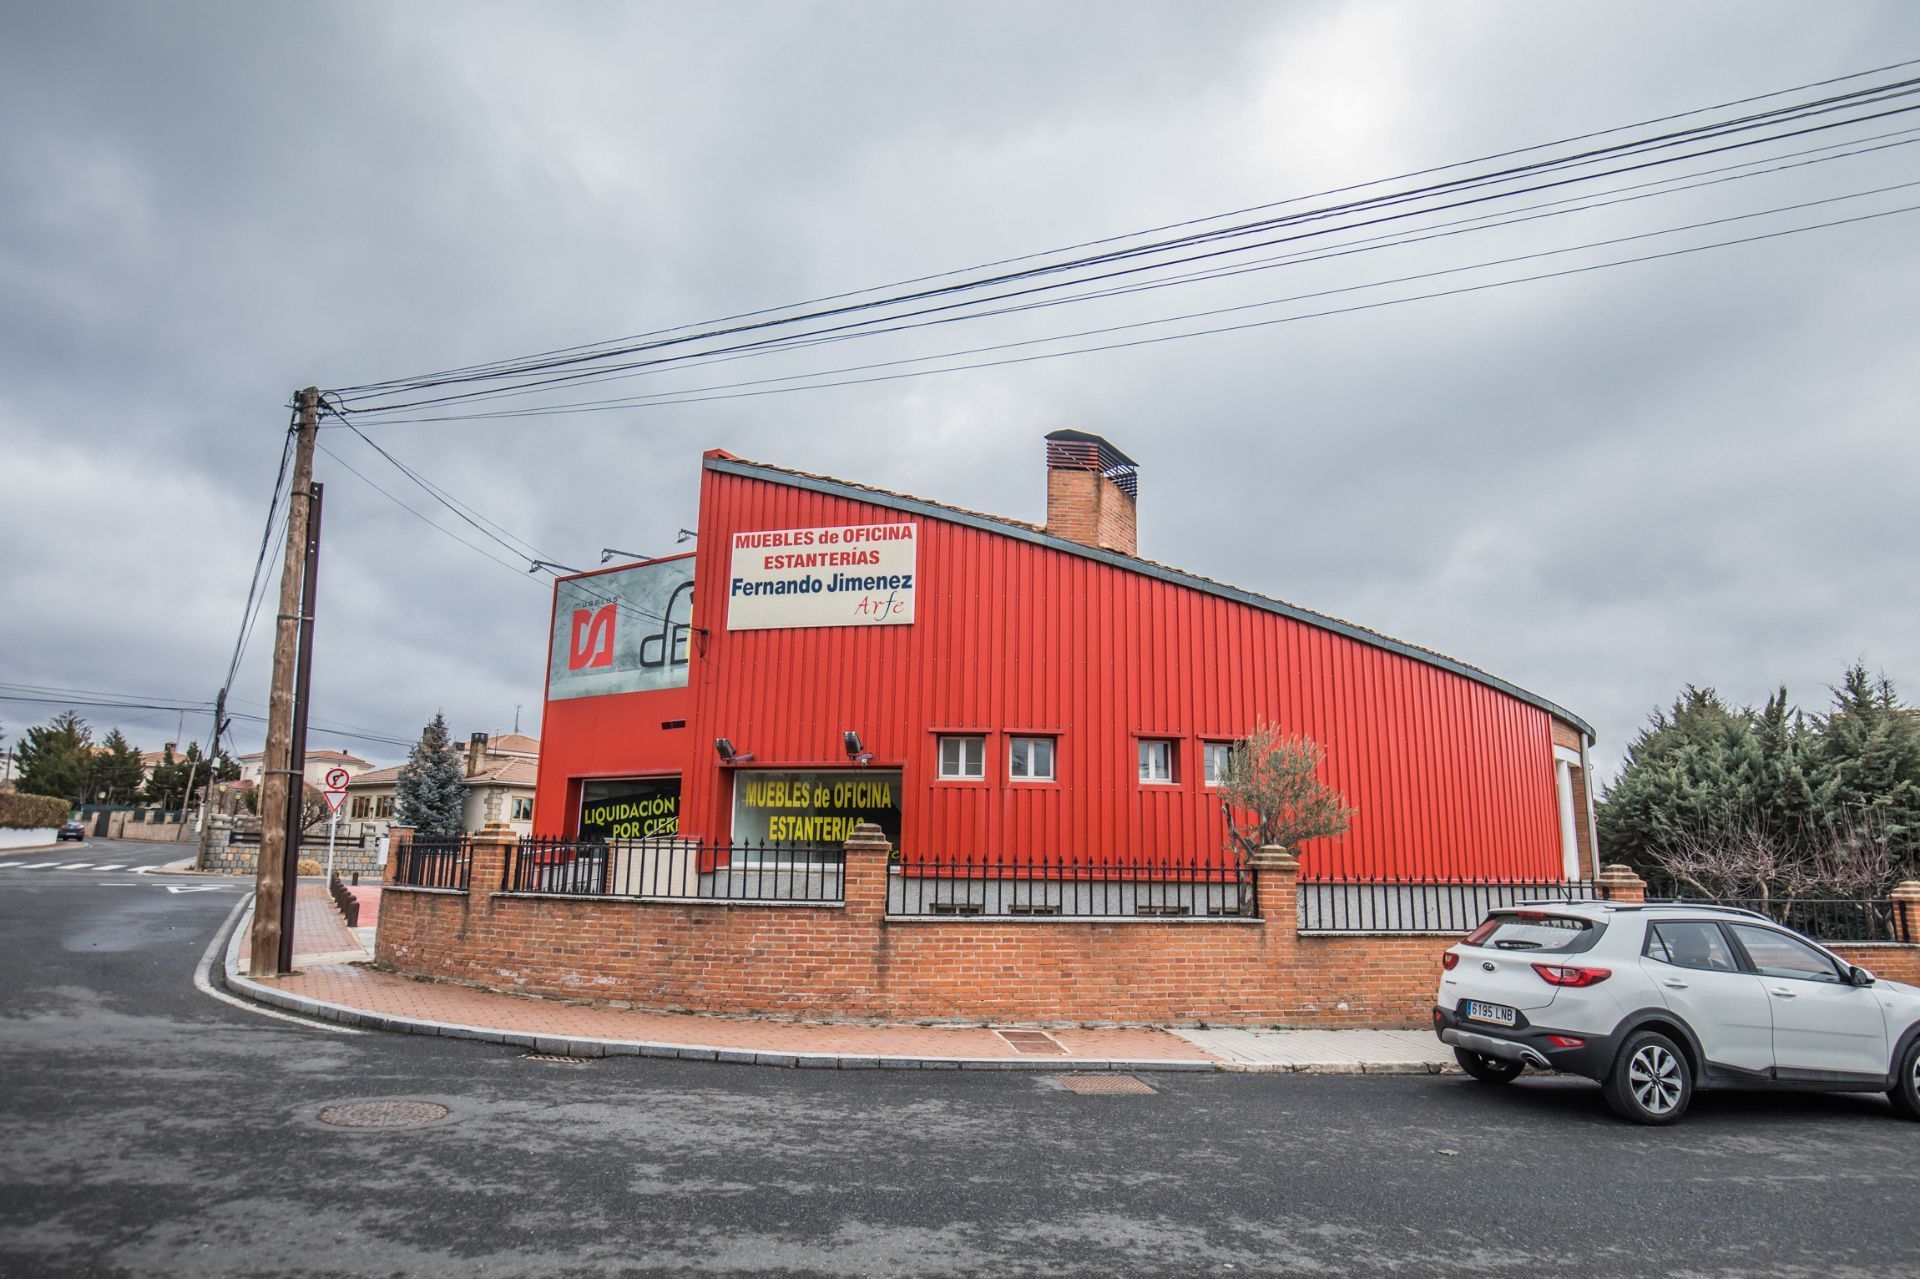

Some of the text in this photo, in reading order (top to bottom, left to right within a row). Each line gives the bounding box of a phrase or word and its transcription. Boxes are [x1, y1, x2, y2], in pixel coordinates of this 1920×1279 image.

[735, 525, 913, 549] MUEBLES de OFICINA
[764, 547, 880, 570] ESTANTERÍAS
[731, 573, 913, 597] Fernando Jimenez
[854, 590, 904, 622] Arfe
[745, 781, 892, 809] MUEBLES de OFICINA
[584, 794, 675, 826] LIQUIDACIÓN
[613, 821, 640, 839] POR
[769, 816, 865, 842] ESTANTERIA
[1472, 1003, 1513, 1021] 6195 LNB
